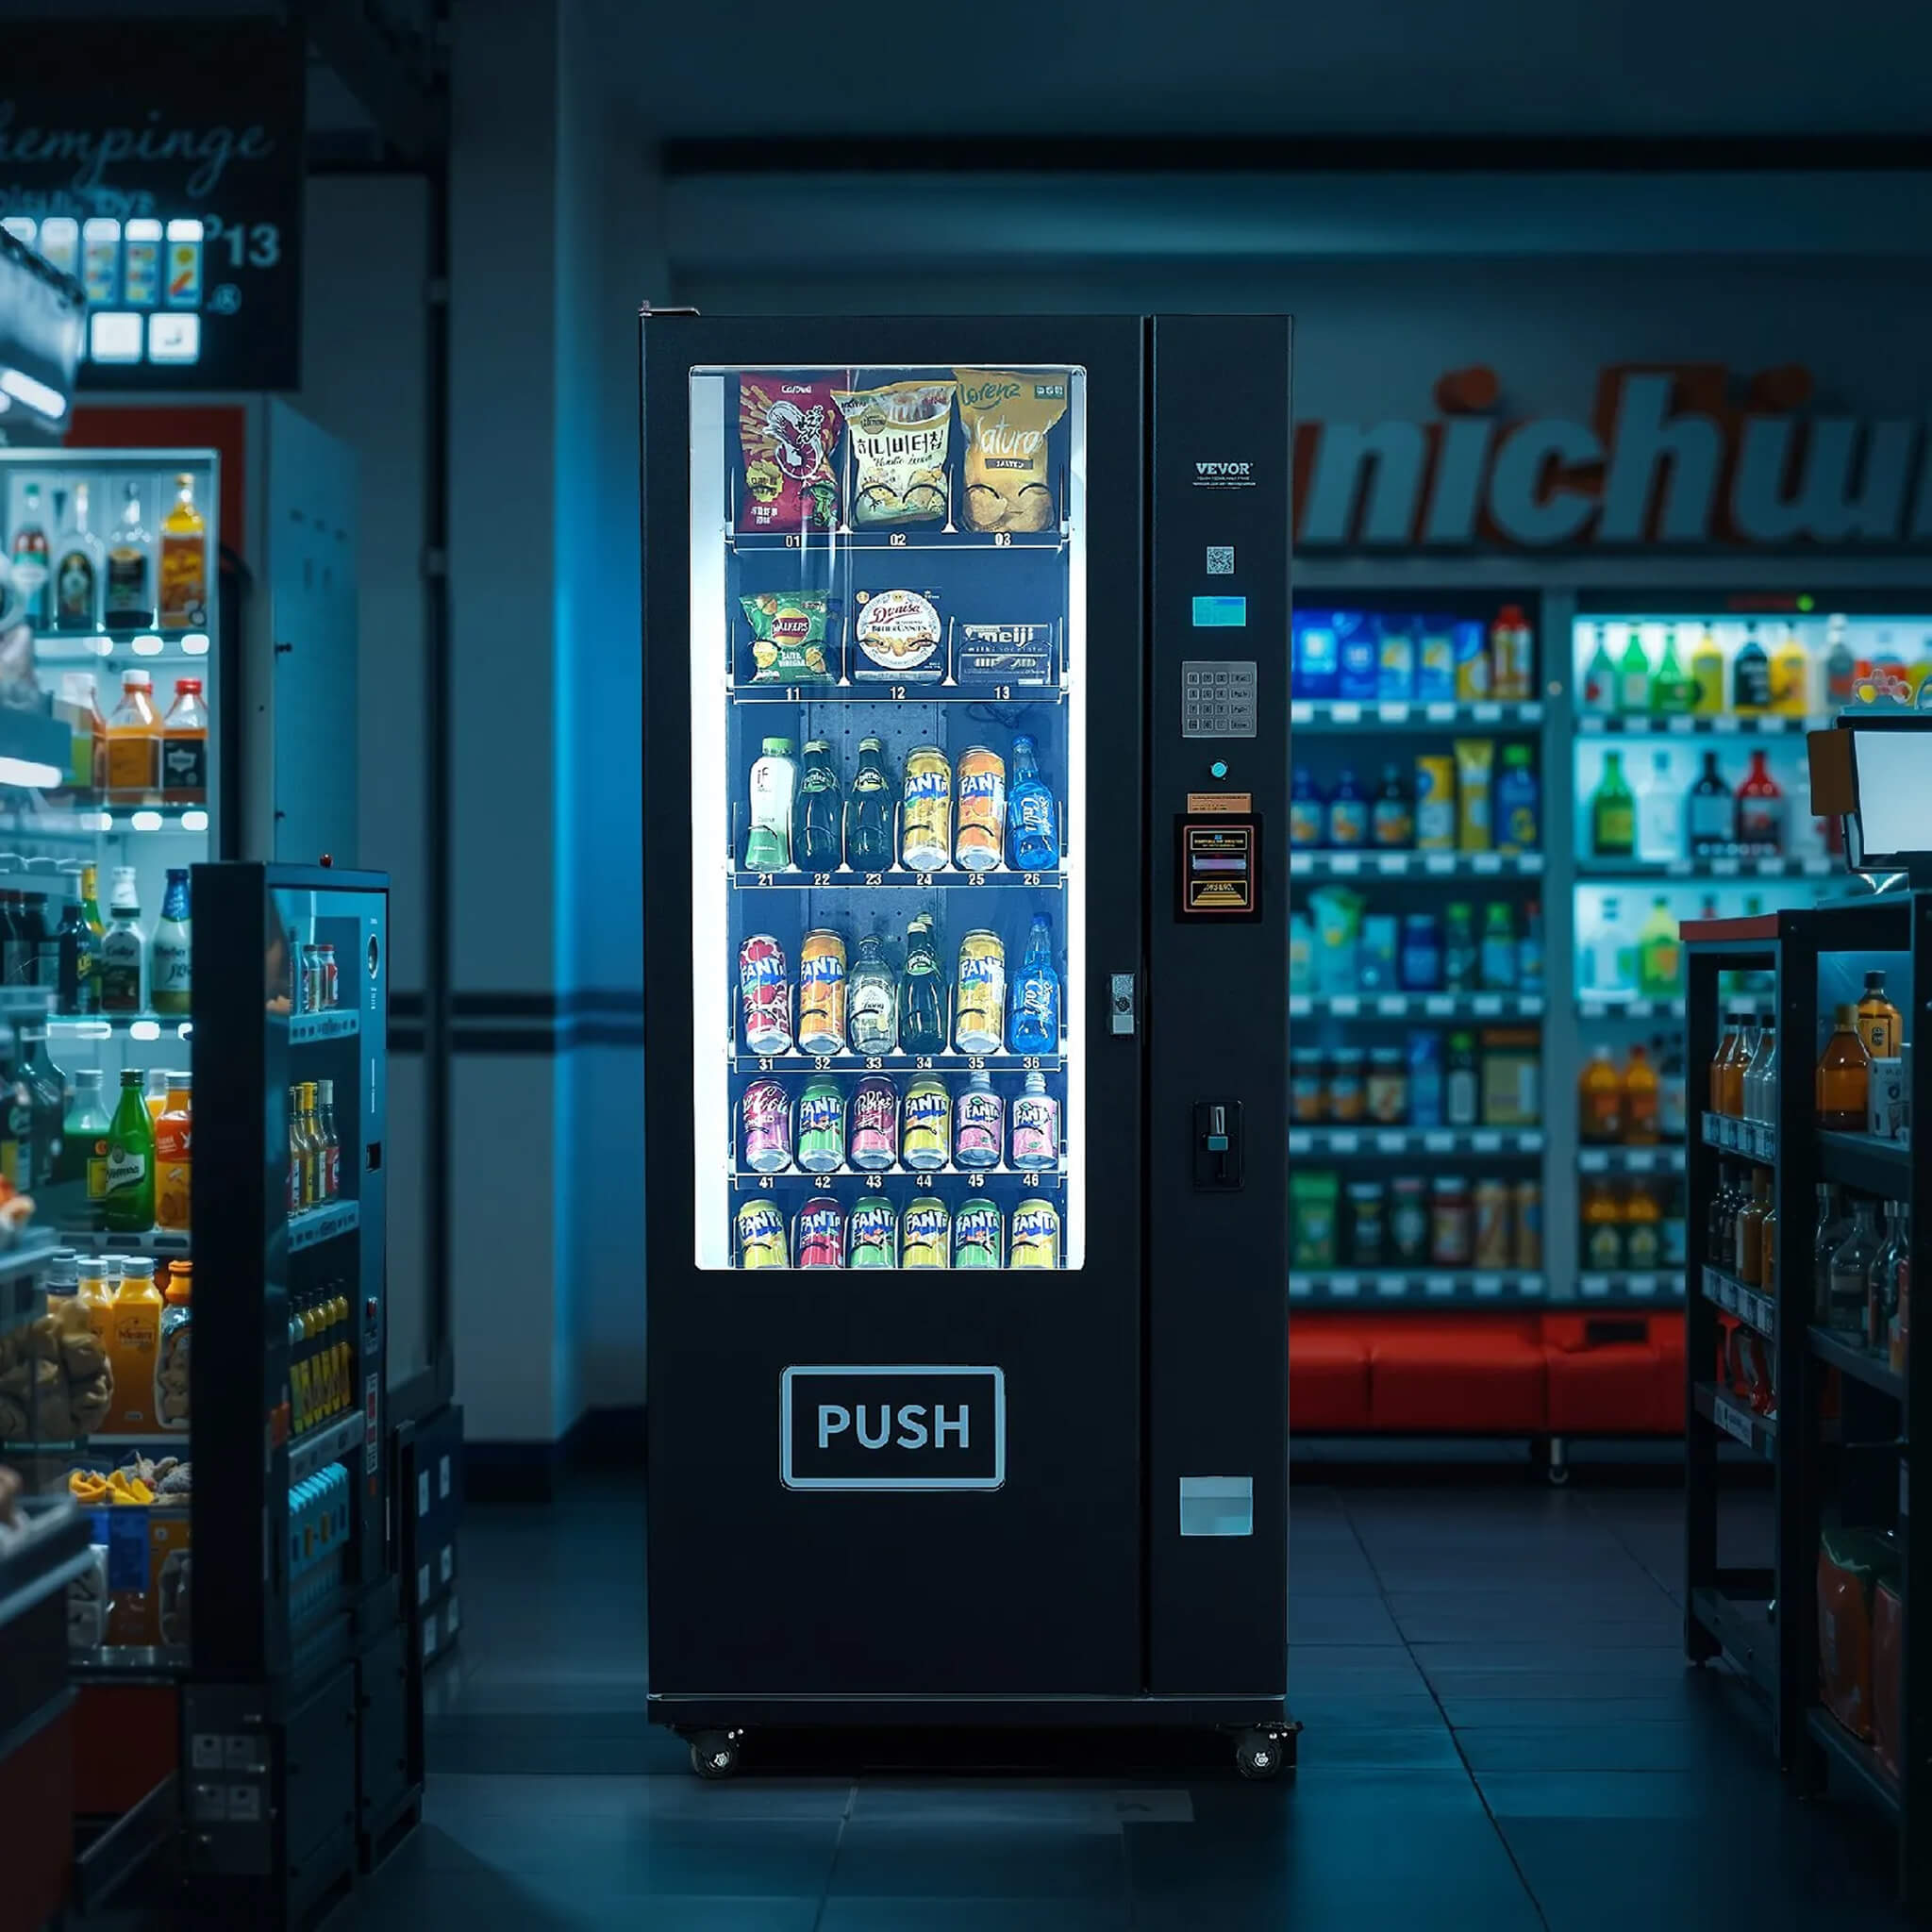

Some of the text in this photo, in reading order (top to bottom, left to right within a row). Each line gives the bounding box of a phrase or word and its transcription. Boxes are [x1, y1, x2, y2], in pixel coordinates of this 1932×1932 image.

[1195, 462, 1250, 475] VEVOR
[785, 534, 801, 547] 01
[890, 534, 906, 547] 02
[994, 533, 1011, 546] 03
[978, 626, 1034, 647] meiji
[785, 687, 800, 700] 11
[890, 686, 906, 699] 12
[993, 686, 1010, 699] 13
[758, 874, 774, 886] 21
[814, 874, 830, 886] 22
[866, 874, 882, 886] 23
[916, 874, 932, 886] 24
[968, 874, 985, 886] 25
[1024, 874, 1040, 886] 26
[758, 1058, 774, 1070] 31
[866, 1058, 882, 1070] 33
[916, 1057, 932, 1069] 34
[968, 1057, 985, 1069] 35
[1023, 1057, 1040, 1069] 36
[758, 1176, 774, 1188] 41
[814, 1176, 831, 1188] 42
[866, 1175, 882, 1188] 43
[916, 1175, 932, 1187] 44
[968, 1175, 984, 1187] 45
[1023, 1175, 1039, 1187] 46
[818, 1404, 969, 1449] PUSH
